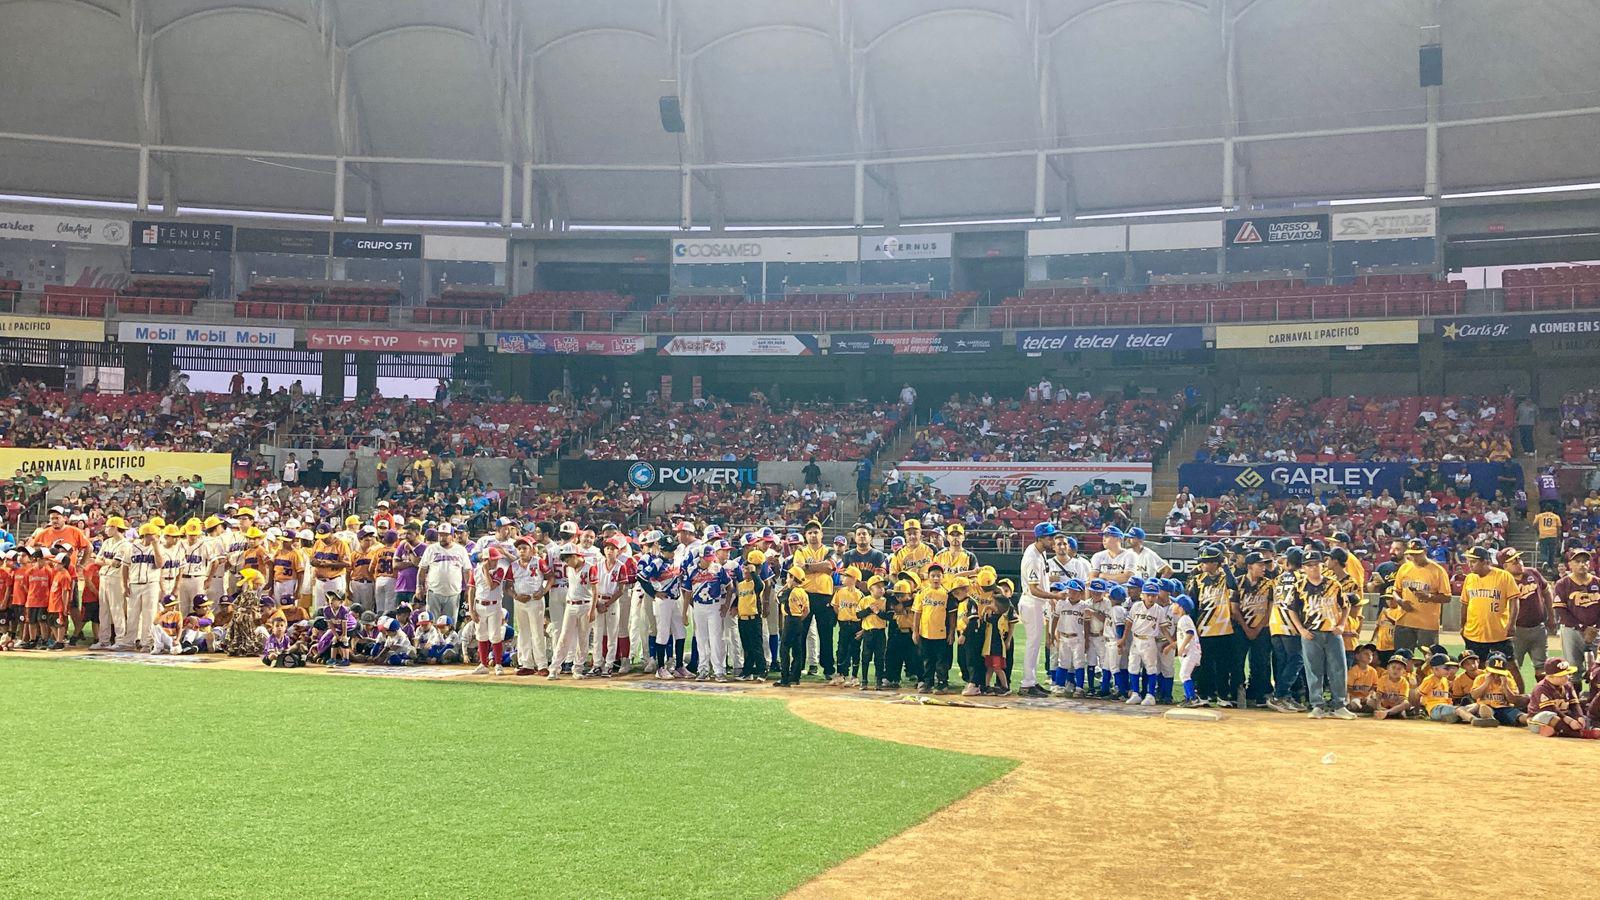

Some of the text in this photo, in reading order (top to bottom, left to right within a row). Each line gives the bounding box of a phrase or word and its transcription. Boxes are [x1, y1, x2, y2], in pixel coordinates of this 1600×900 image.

[160, 227, 221, 240] TENURE
[1270, 223, 1309, 232] LARSSO
[1269, 230, 1321, 241] ELEVATOR
[357, 240, 413, 250] GRUPO STI
[689, 243, 762, 257] COSAMED
[1458, 323, 1491, 337] Carl's
[1529, 323, 1538, 333] A
[1539, 322, 1576, 333] COMER
[1577, 321, 1592, 332] EN
[136, 327, 176, 341] Mobil
[186, 329, 226, 343] Mobil
[236, 331, 276, 345] Mobil
[326, 334, 352, 345] TVP
[1126, 333, 1173, 348] telcel
[1269, 331, 1312, 344] CARNAVAL
[372, 336, 399, 347] TVP
[432, 337, 458, 348] TVP
[1023, 335, 1067, 350] telcel
[1074, 334, 1119, 349] telcel
[22, 459, 82, 473] CARNAVAL
[93, 455, 146, 470] PACIFICO
[1271, 467, 1381, 485] GARLEY
[1543, 477, 1555, 489] 23
[1543, 518, 1552, 527] 18
[1490, 602, 1499, 612] 12
